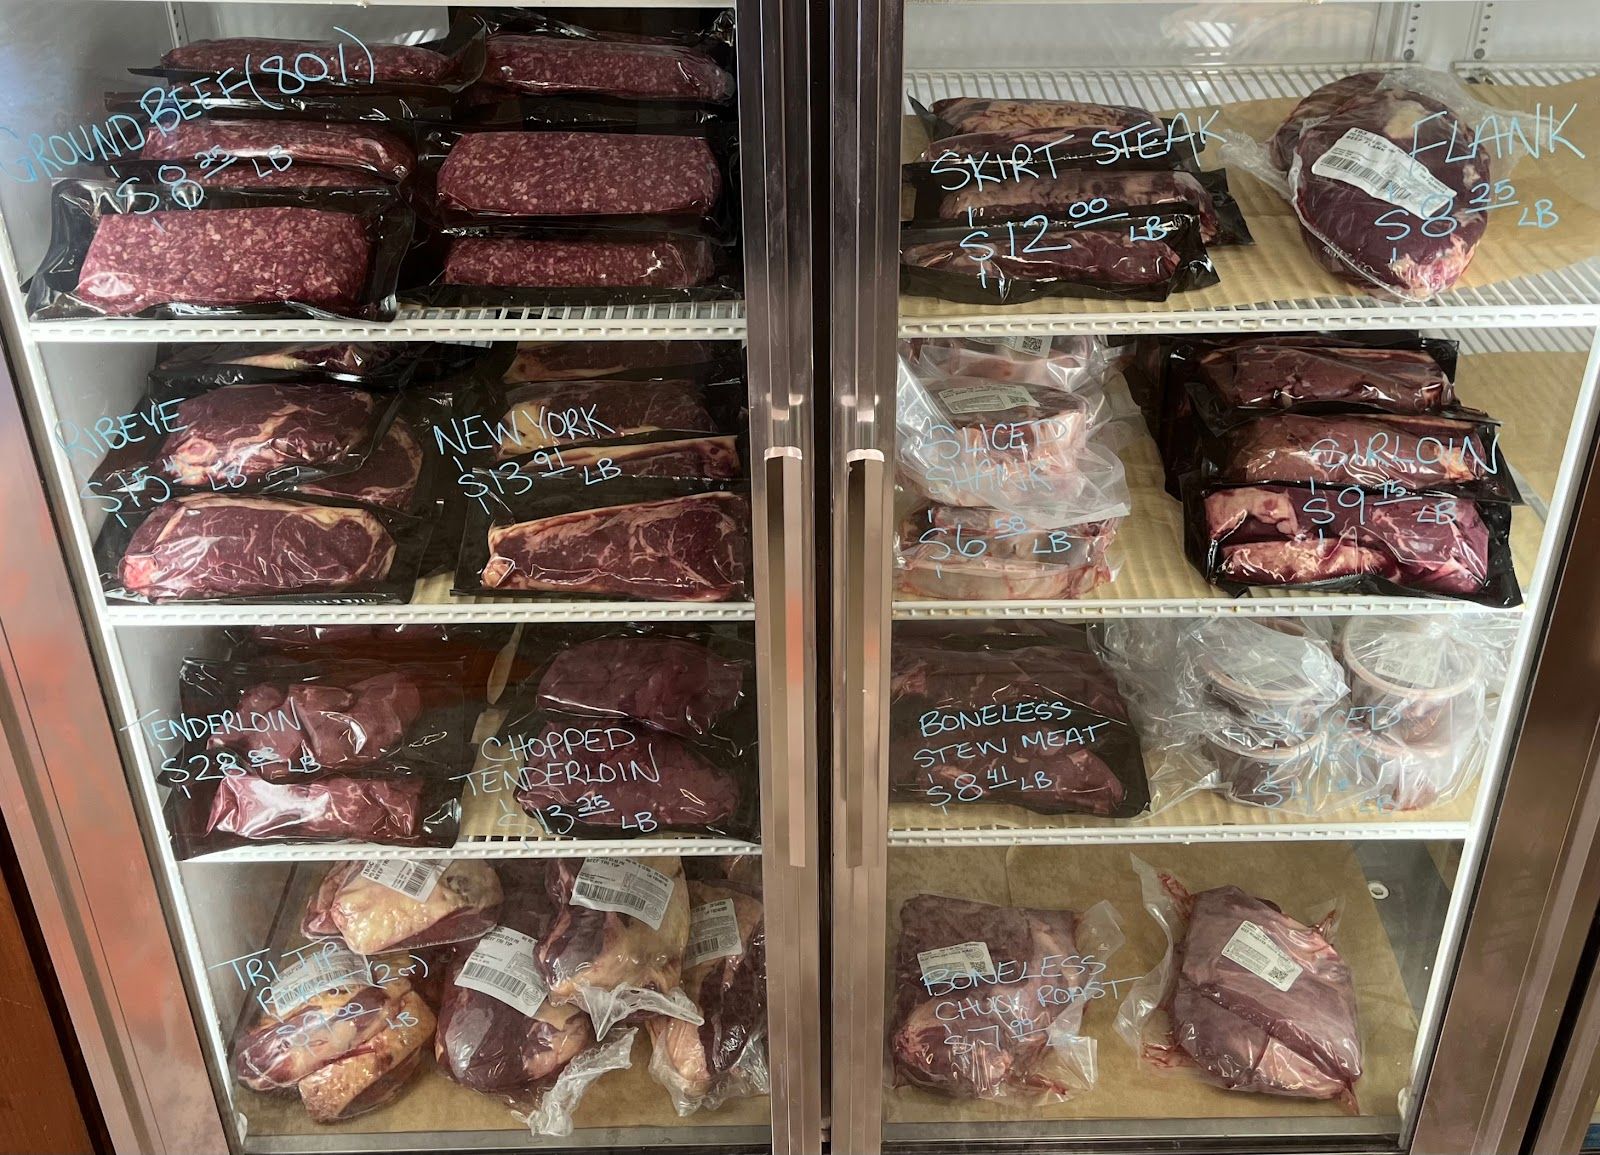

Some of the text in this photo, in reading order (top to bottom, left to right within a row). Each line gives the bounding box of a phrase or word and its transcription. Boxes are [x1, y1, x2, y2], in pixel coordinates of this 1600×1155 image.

[0, 113, 147, 184] GROUND
[140, 67, 249, 138] BEEF
[1407, 102, 1586, 177] FLANK
[251, 144, 293, 177] LB
[930, 110, 1228, 192] SKIRT STEAK
[1129, 215, 1169, 243] LB
[1517, 198, 1560, 229] LB
[54, 397, 188, 459] RIBEYE
[433, 403, 616, 456] NEW YORK
[920, 418, 1067, 459] SLICED
[583, 457, 622, 486] LB
[1309, 431, 1500, 475] SIRLOIN
[925, 459, 1053, 494] SHANK
[1416, 500, 1457, 525] LB
[1032, 530, 1072, 554] LB
[119, 696, 302, 747] TENDERLOIN
[919, 701, 1072, 738] BONELESS
[288, 755, 322, 774] LB
[481, 728, 636, 762] CHOPPED
[913, 721, 1111, 769] STEW MEAT
[448, 743, 660, 796] TENDERLOIN
[1021, 771, 1053, 791] LB
[621, 811, 658, 832] LB
[209, 947, 281, 991] TRI
[280, 935, 340, 970] TIP
[919, 955, 1106, 997] BONELESS
[935, 976, 1145, 1021] CHUCK ROAST
[386, 1011, 419, 1030] LB
